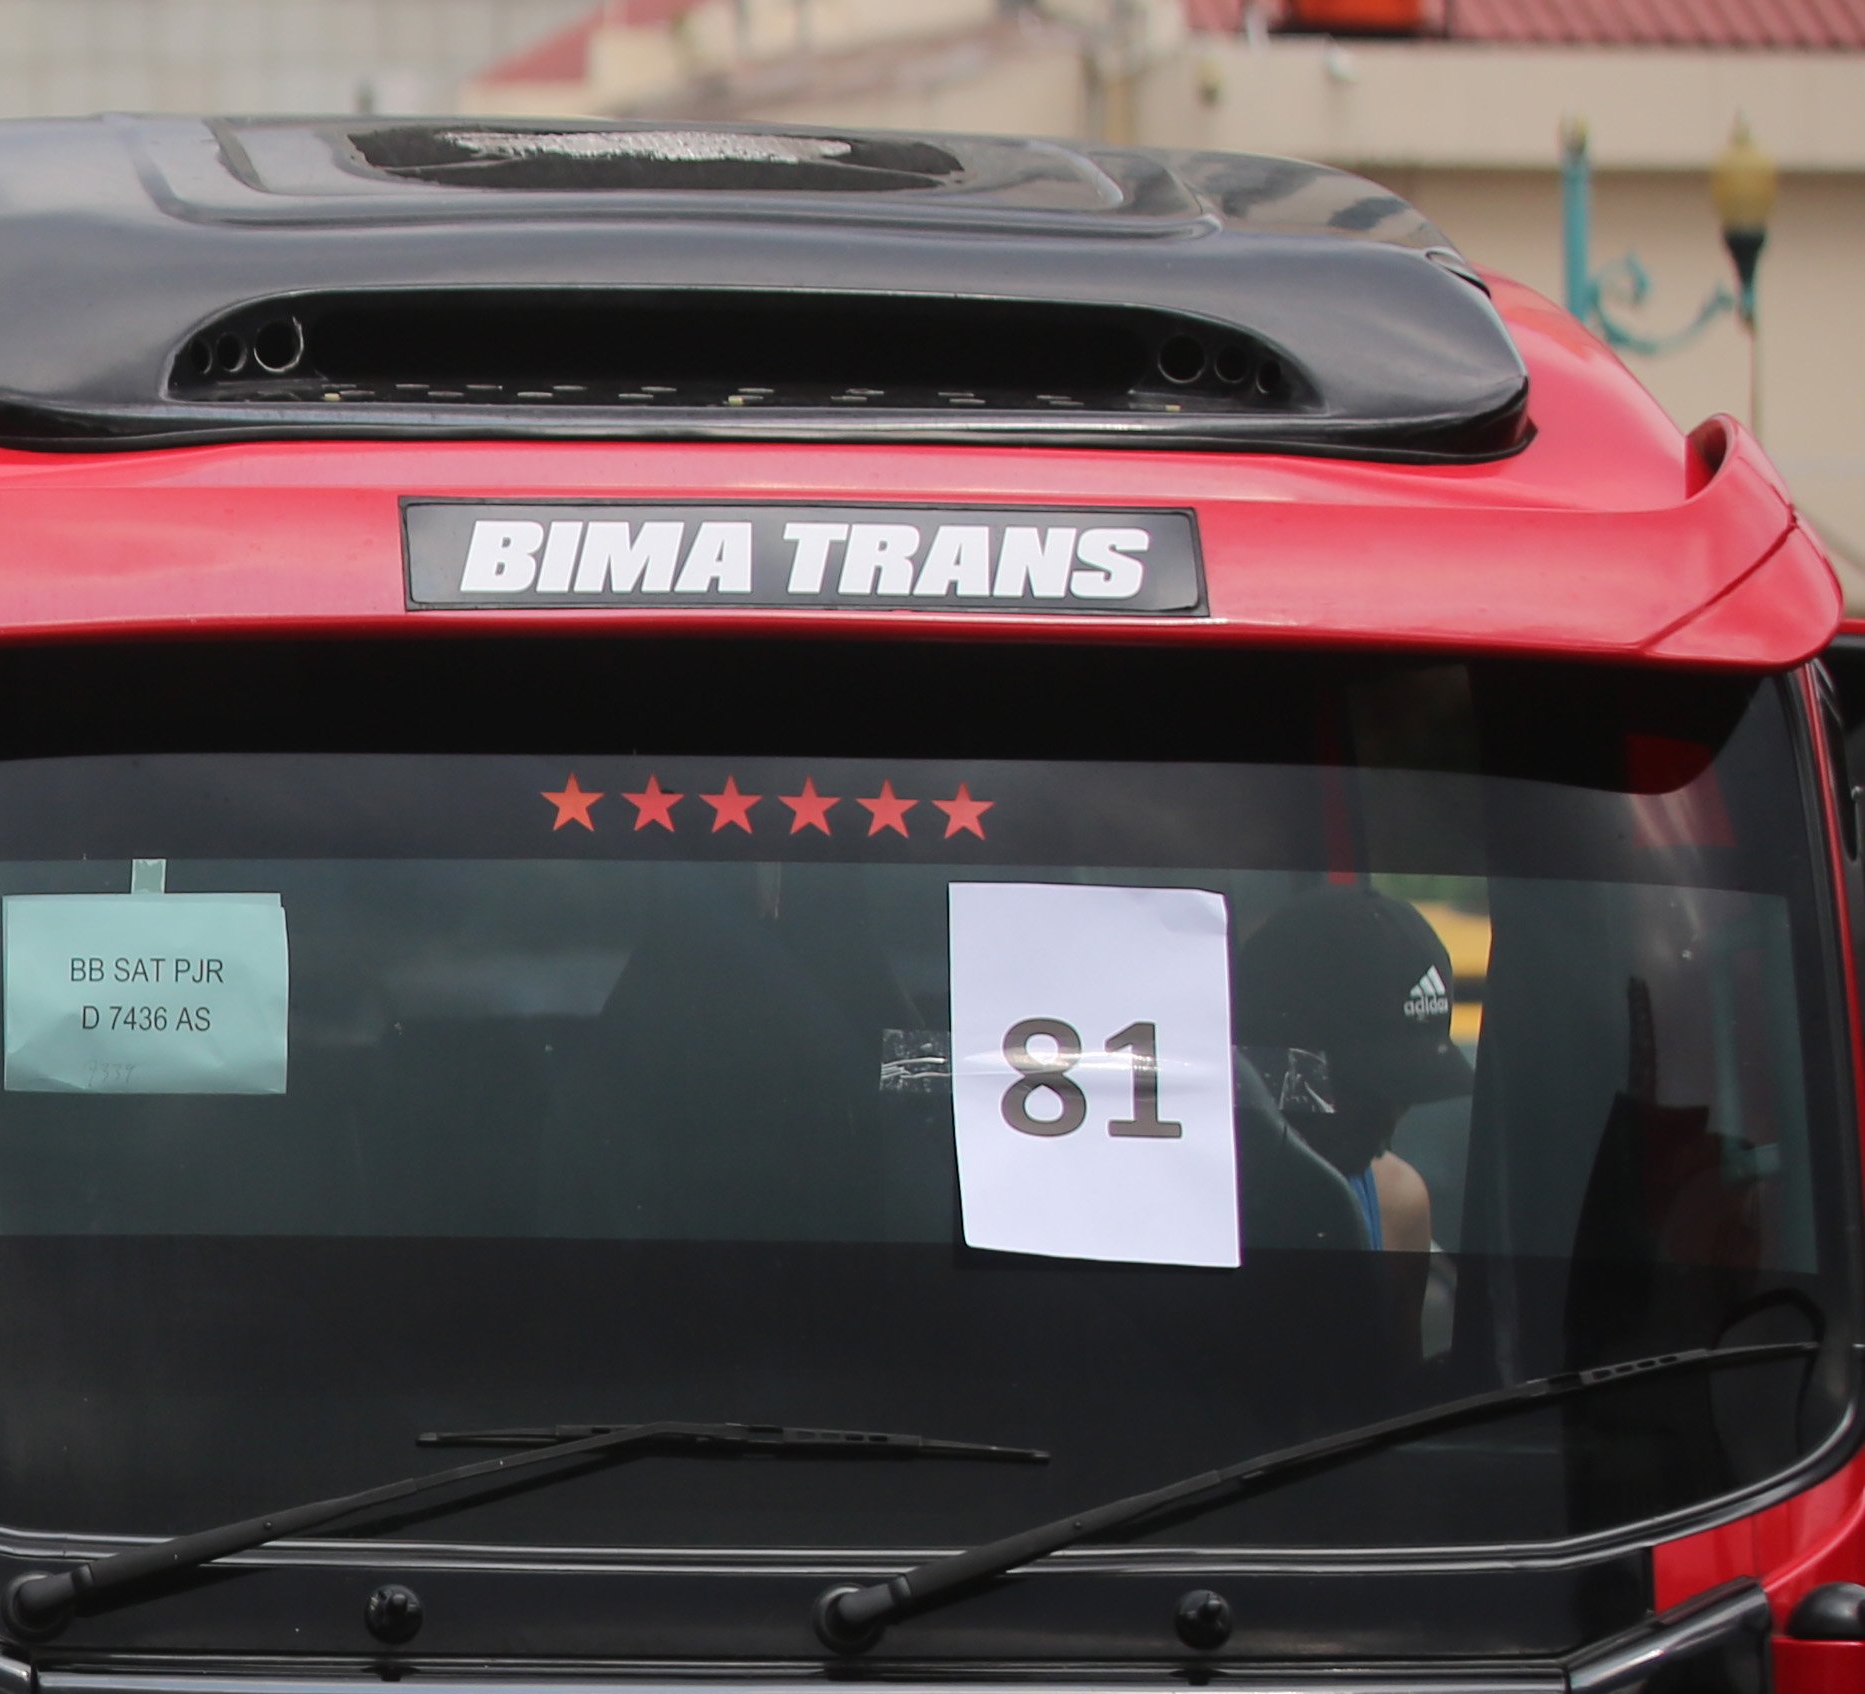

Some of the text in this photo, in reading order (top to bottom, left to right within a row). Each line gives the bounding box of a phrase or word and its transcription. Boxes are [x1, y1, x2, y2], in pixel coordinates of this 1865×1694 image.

[460, 519, 1150, 600] BIMA TRANS
[69, 957, 224, 984] BB SAT PJR
[81, 1005, 211, 1032] D 7436 AS
[1403, 994, 1449, 1017] adida
[1000, 1017, 1183, 1139] 81
